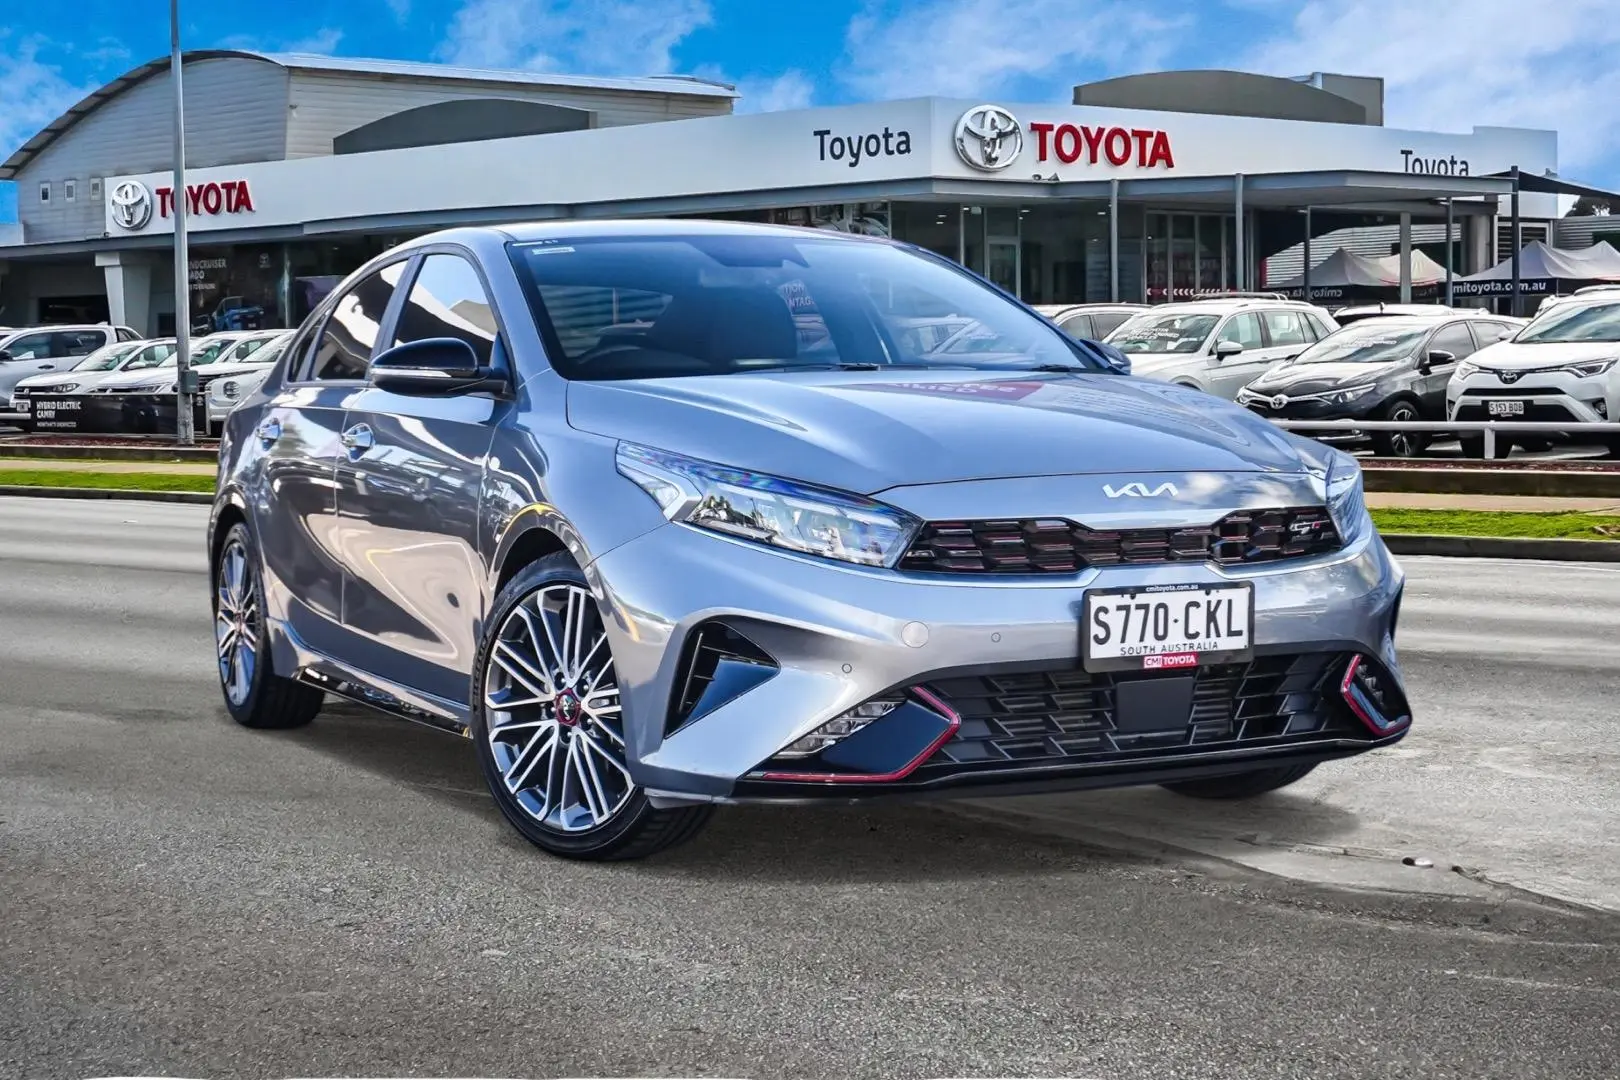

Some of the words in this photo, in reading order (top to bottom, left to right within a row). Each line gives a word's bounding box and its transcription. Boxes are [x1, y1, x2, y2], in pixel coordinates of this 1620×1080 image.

[813, 127, 911, 168] Toyota
[1030, 122, 1175, 169] TOYOTA
[1453, 281, 1547, 294] mitoyota.cm.au
[36, 401, 57, 410] HYBRID
[57, 401, 81, 410] ELECTRIC
[1145, 584, 1199, 593] cmitoyota.com.au
[1120, 645, 1156, 656] SOUTH
[1160, 641, 1219, 653] AUSTRALIA
[1163, 654, 1197, 666] TOYOTA
